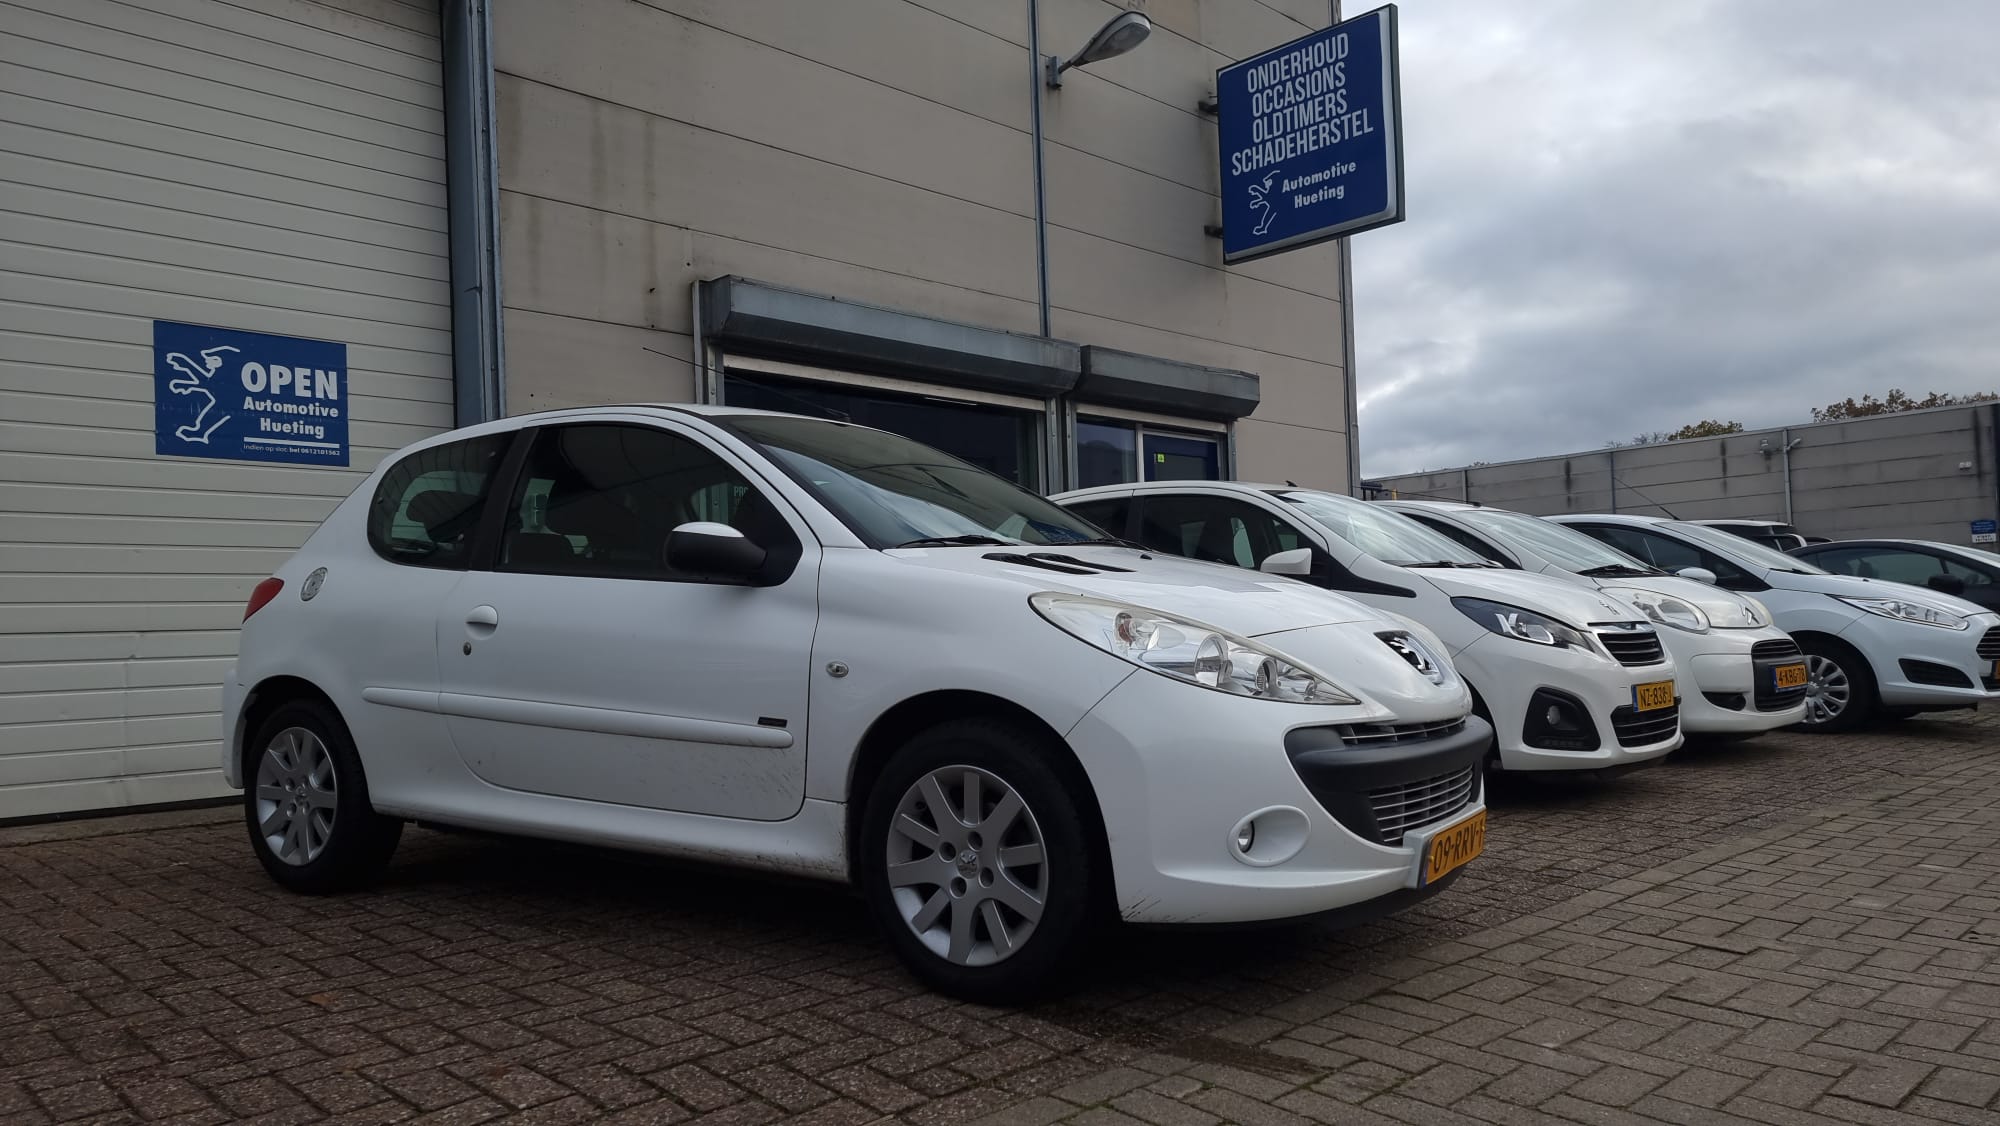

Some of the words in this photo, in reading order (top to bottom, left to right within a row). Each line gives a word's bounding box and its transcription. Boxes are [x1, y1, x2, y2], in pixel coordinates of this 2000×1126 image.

[1247, 32, 1349, 94] ONDERHOUD
[1252, 61, 1346, 118] OCCASIONS
[1252, 88, 1348, 144] OLDTIMERS
[1231, 107, 1374, 176] SCHADEHERSTEL
[1281, 161, 1357, 194] Automotive
[1294, 184, 1346, 209] Hueting
[241, 361, 338, 401] OPEN
[243, 396, 340, 418] Automotive
[260, 417, 325, 440] Hueting
